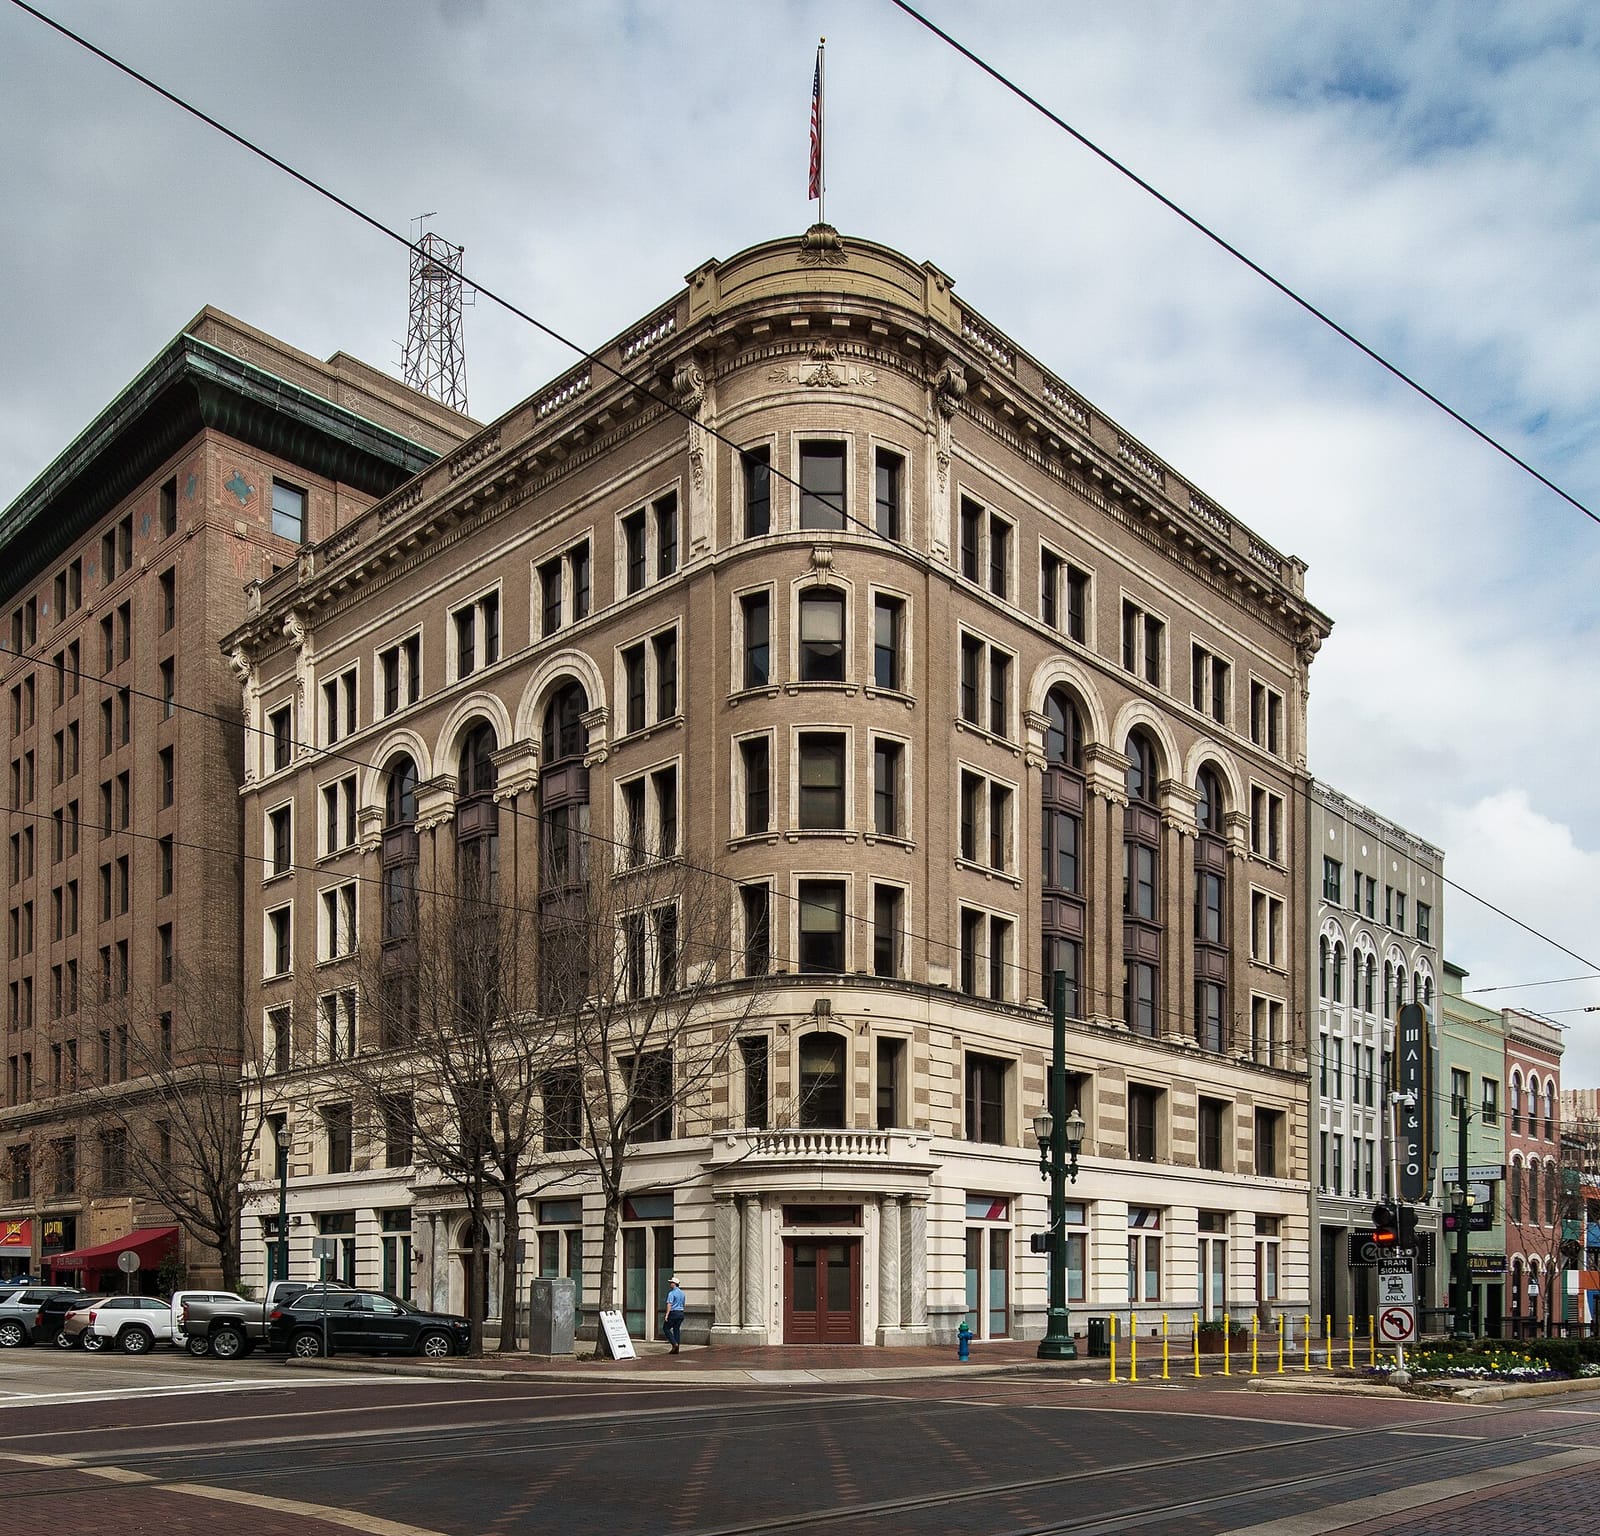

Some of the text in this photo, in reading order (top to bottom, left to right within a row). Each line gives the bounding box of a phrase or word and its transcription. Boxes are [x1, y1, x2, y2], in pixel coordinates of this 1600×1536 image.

[1407, 1115, 1418, 1128] &
[1406, 1143, 1419, 1176] CO
[1385, 1294, 1407, 1302] ONLY
